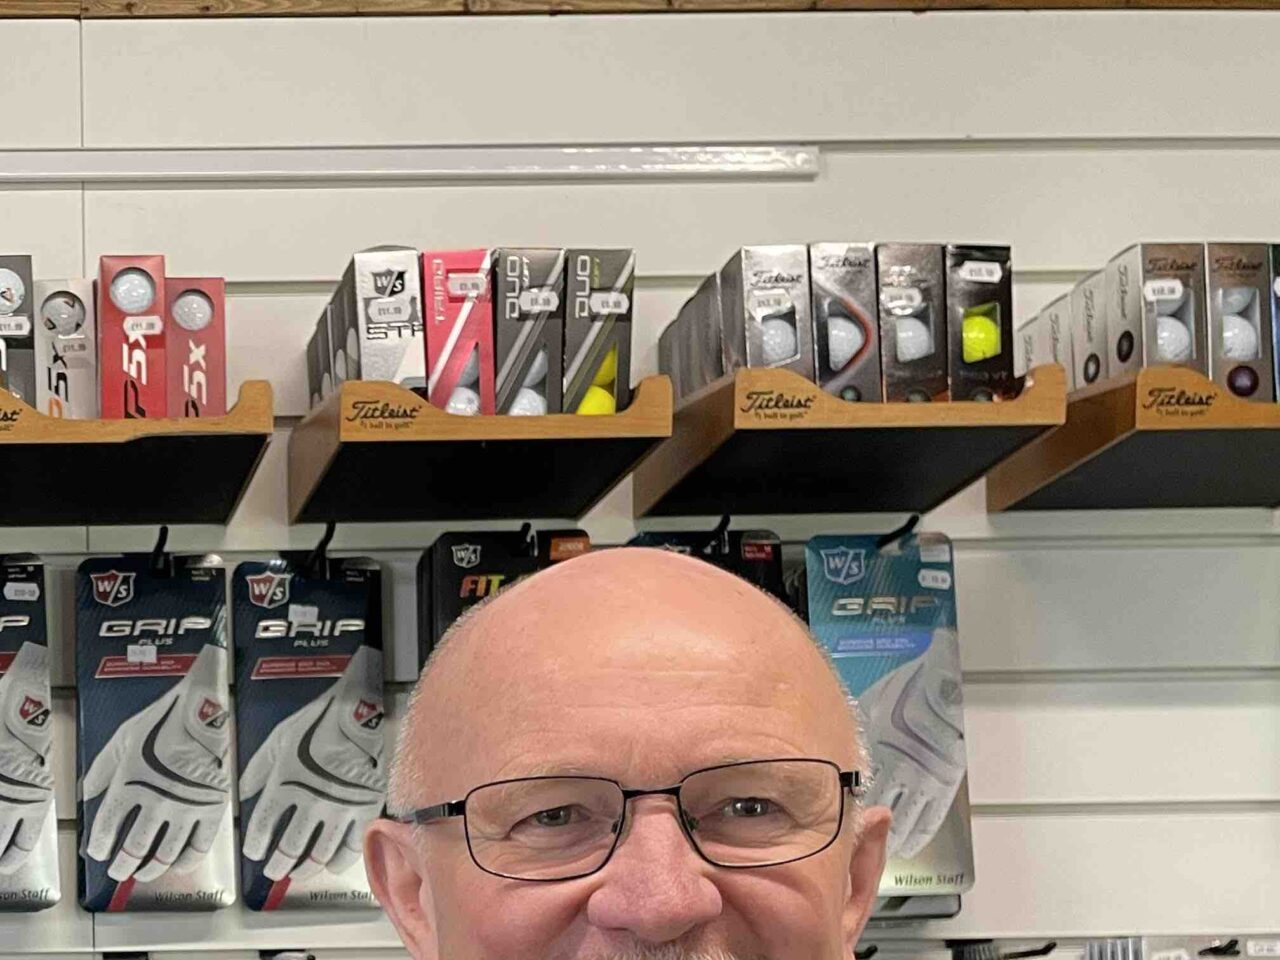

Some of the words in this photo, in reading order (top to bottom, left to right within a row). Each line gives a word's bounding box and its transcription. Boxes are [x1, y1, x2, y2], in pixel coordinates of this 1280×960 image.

[740, 390, 817, 413] Titleist
[1142, 387, 1217, 410] Titleist
[346, 400, 422, 422] Titleist
[460, 575, 505, 598] FIT
[832, 595, 939, 616] GRIP
[99, 617, 212, 637] GRIP
[255, 619, 366, 639] GRIP
